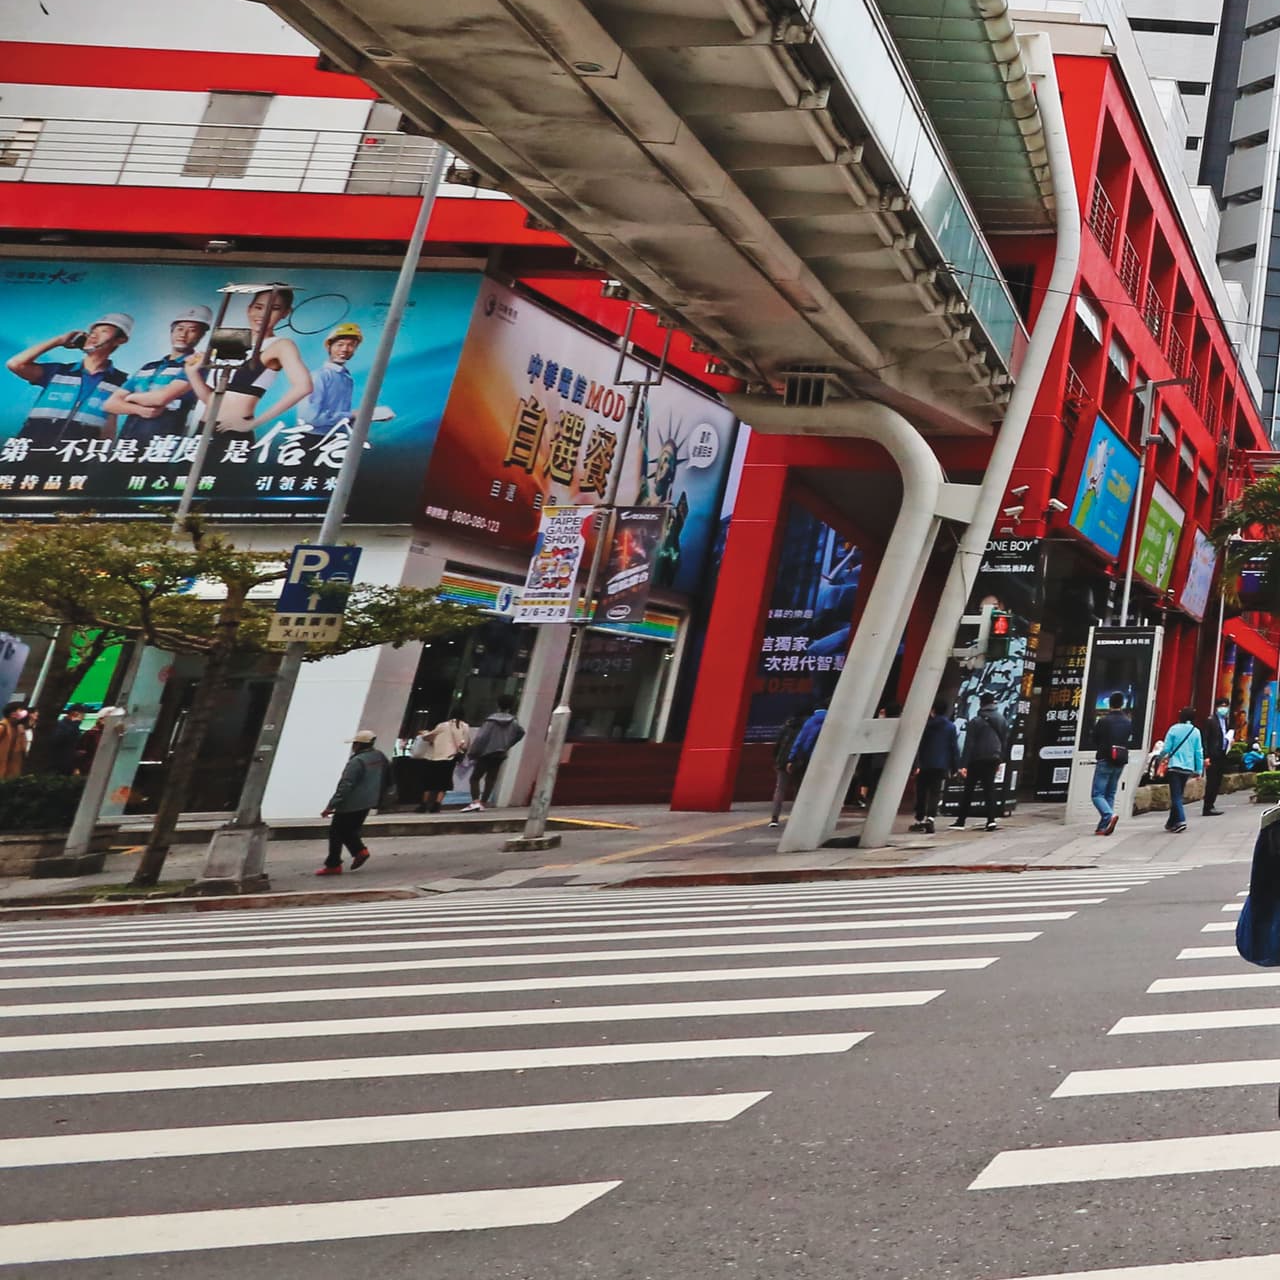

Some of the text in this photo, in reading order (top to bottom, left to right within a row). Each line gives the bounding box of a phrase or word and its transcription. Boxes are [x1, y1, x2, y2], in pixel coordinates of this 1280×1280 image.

[546, 526, 580, 535] GAME
[544, 535, 578, 545] SHOW
[985, 541, 1032, 551] ONE BOY
[289, 549, 331, 584] P
[283, 628, 326, 638] Xinyi
